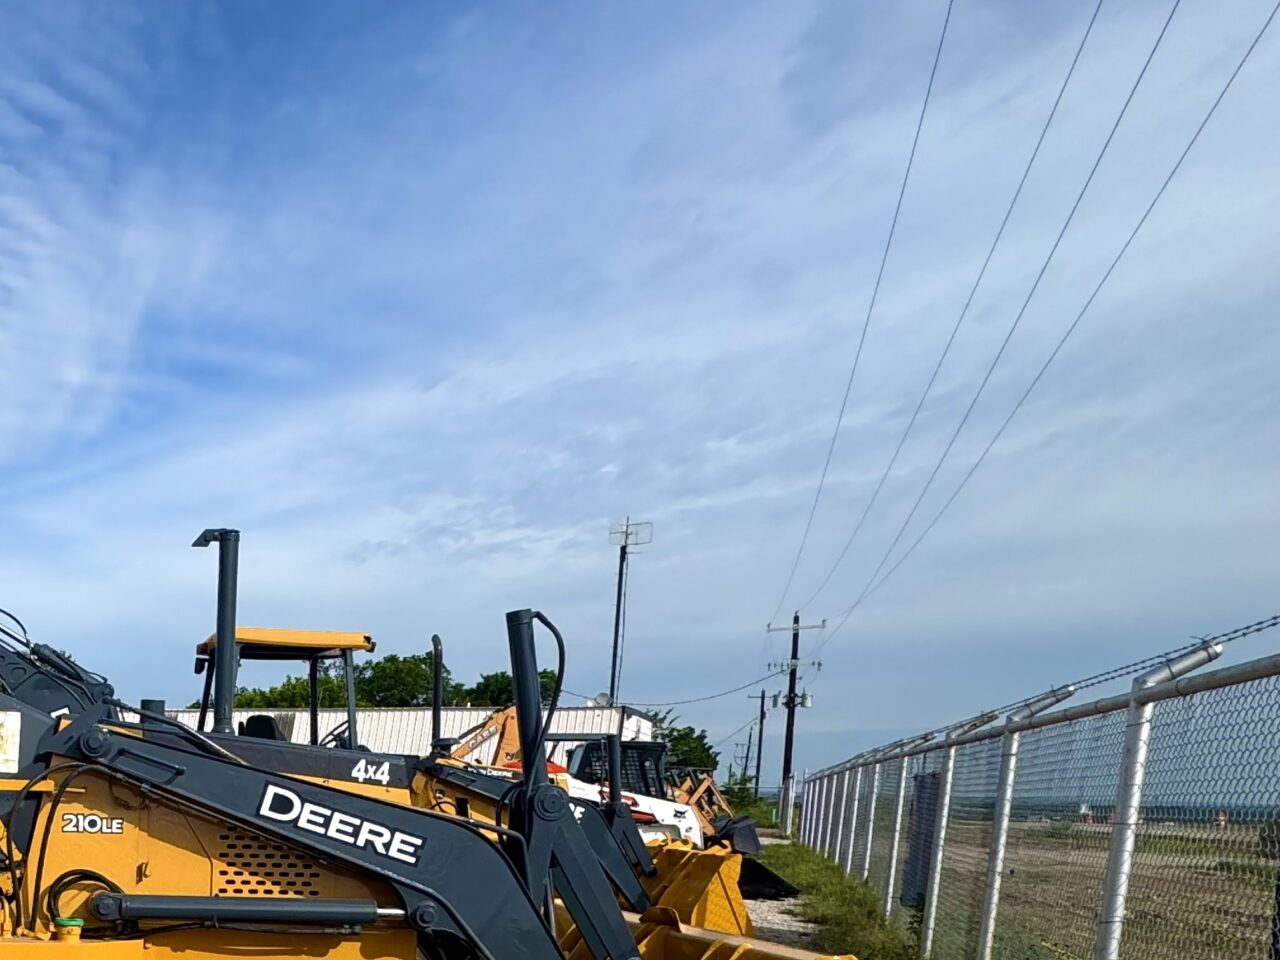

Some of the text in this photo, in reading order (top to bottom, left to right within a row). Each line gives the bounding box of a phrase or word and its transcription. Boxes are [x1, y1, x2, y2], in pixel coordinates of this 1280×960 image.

[351, 758, 390, 785] 4x4
[62, 813, 124, 834] 210LE
[259, 784, 423, 864] DEERE
